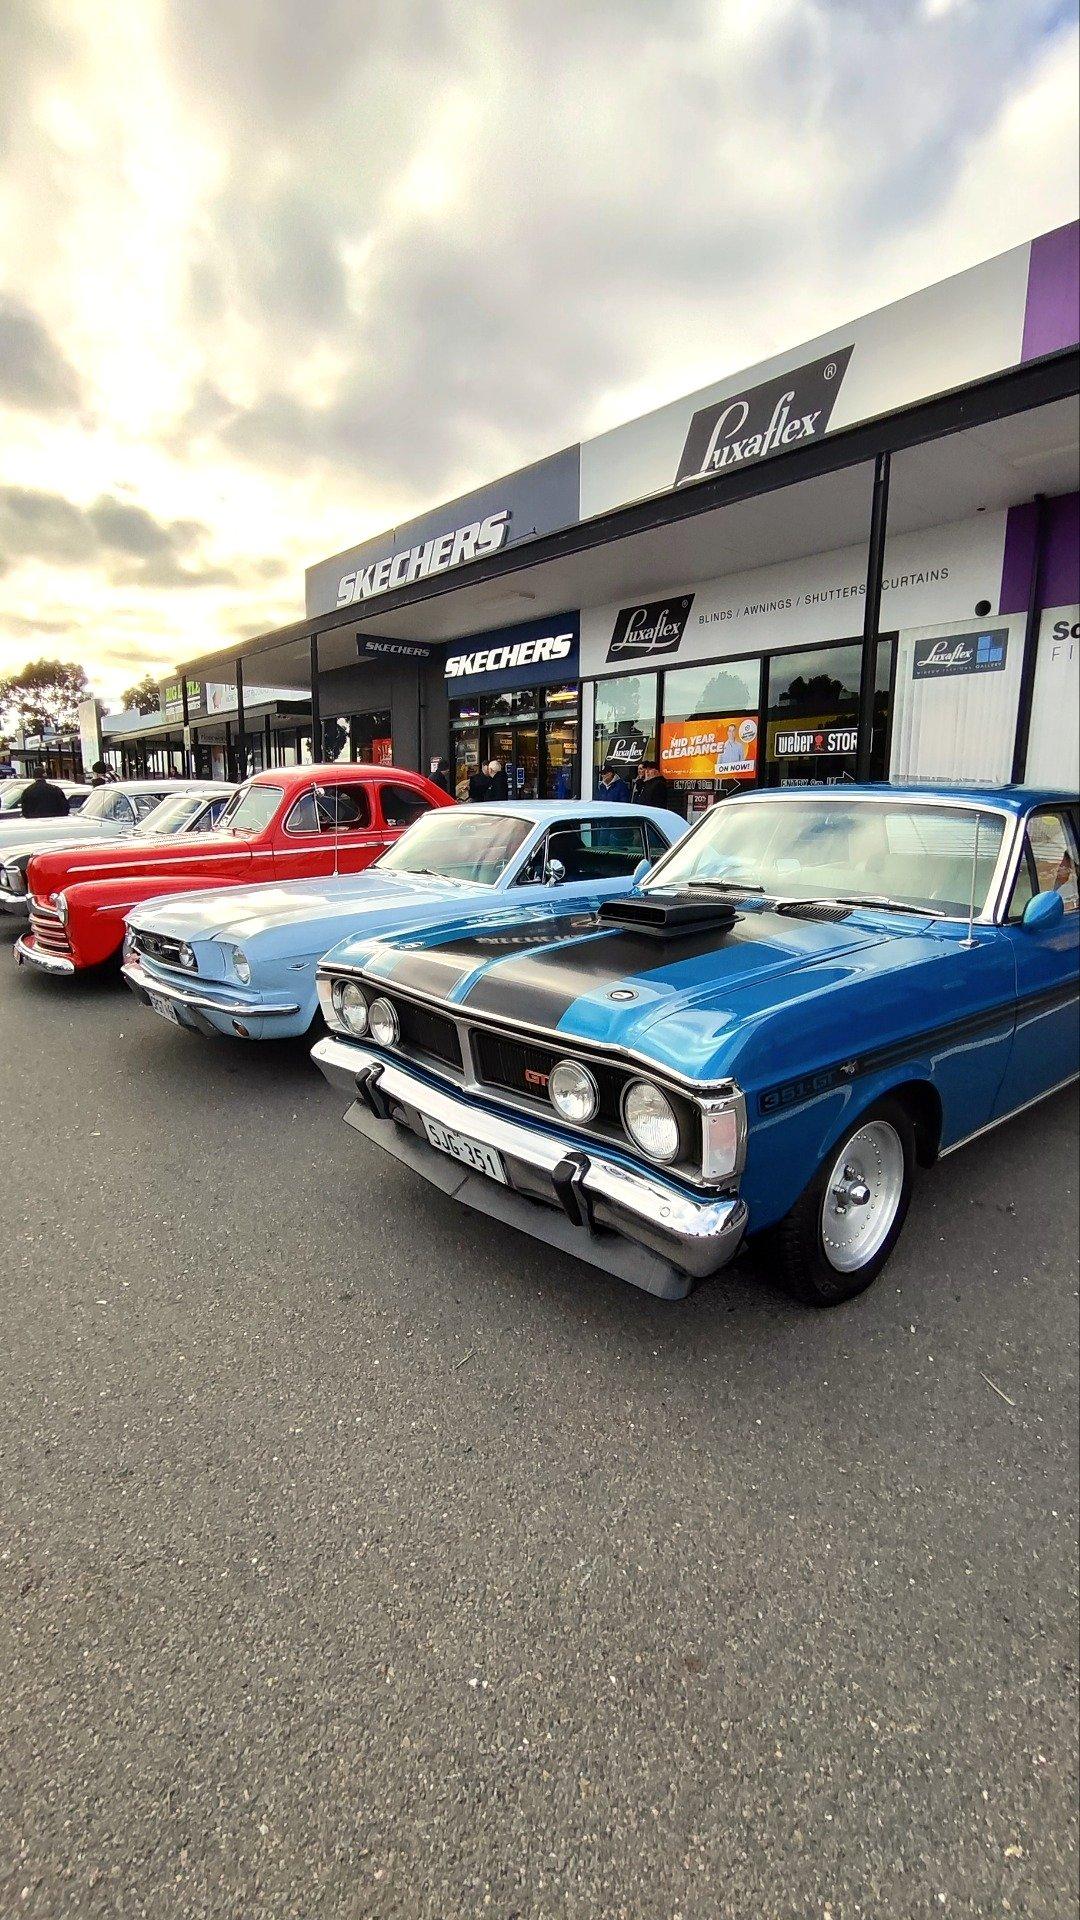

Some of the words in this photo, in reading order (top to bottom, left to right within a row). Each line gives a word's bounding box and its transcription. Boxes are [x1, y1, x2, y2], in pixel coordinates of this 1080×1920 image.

[677, 390, 822, 487] Luxaflex
[336, 509, 511, 607] SKECHERS
[698, 610, 733, 624] BLINDS
[743, 598, 792, 616] AWNINGS
[804, 584, 866, 605] SHUTTERS
[880, 567, 949, 591] CURTAINS
[610, 608, 682, 653] Luxaflex
[365, 641, 431, 657] SKECHERS
[444, 633, 574, 678] SKECHERS
[917, 641, 974, 667] Luxaflex
[605, 739, 644, 764] Luxaflex
[661, 742, 725, 760] CLEARANCE
[670, 737, 688, 748] MID
[690, 733, 716, 746] YEAR
[778, 731, 814, 754] weber
[827, 732, 858, 752] STOR
[718, 764, 729, 773] ON
[730, 763, 750, 772] NOW!
[525, 1068, 550, 1087] GT
